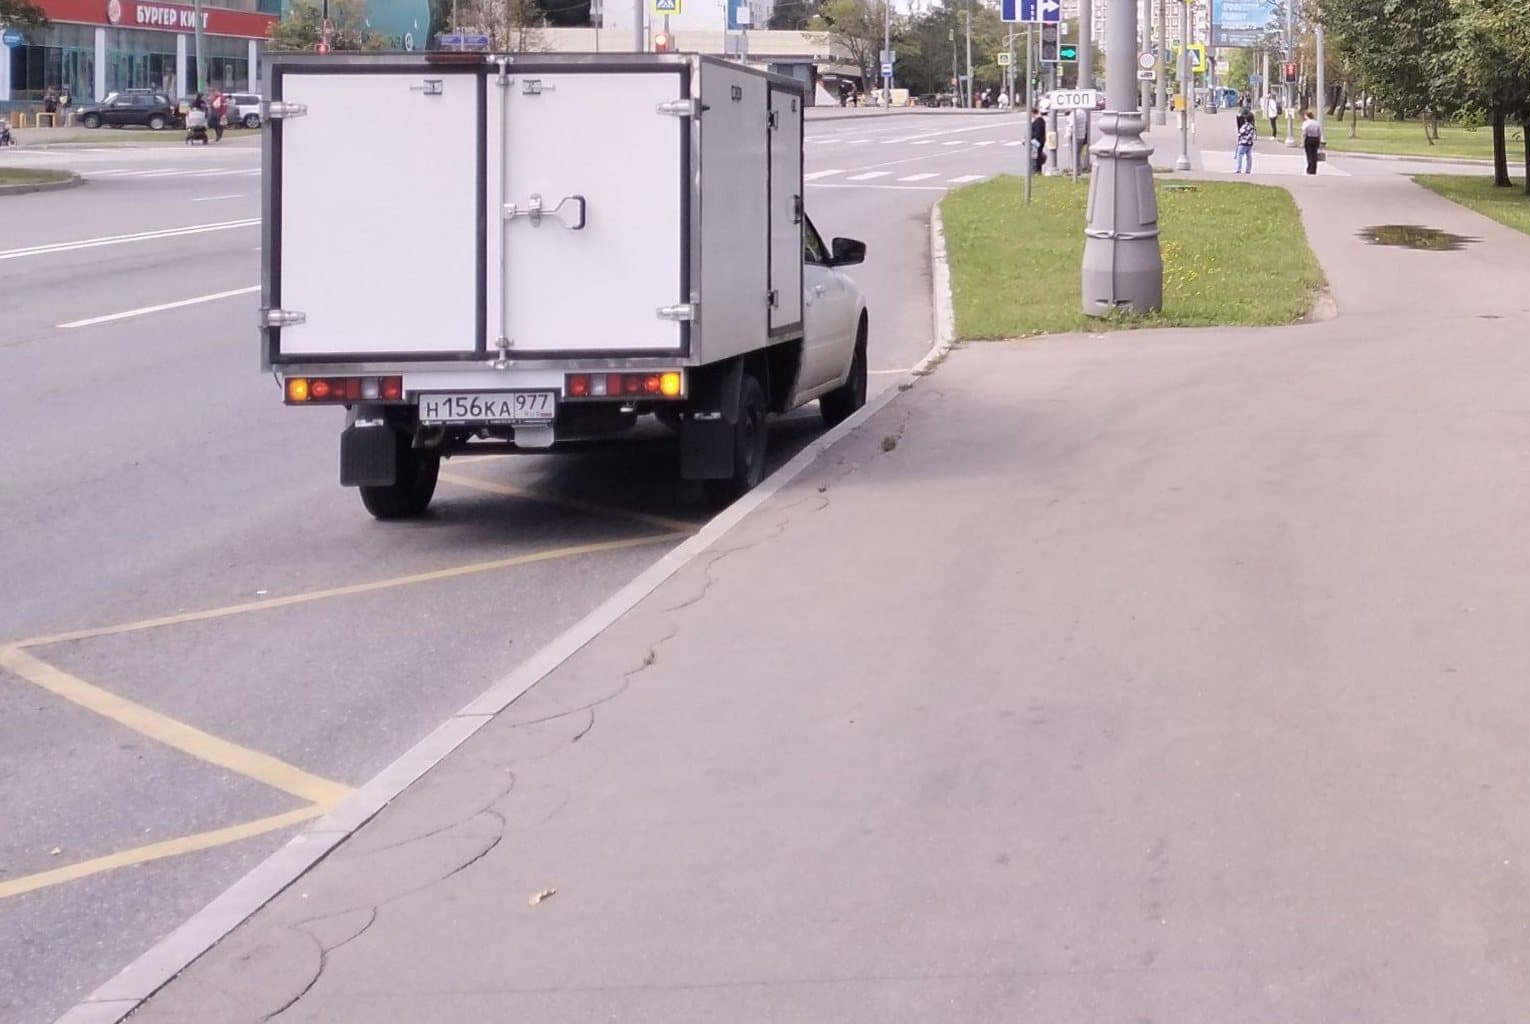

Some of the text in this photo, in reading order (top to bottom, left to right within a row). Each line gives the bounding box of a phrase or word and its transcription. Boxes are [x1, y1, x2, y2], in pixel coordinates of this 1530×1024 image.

[136, 5, 209, 30] БУРГЕР КИГ
[1056, 93, 1090, 105] СТОП
